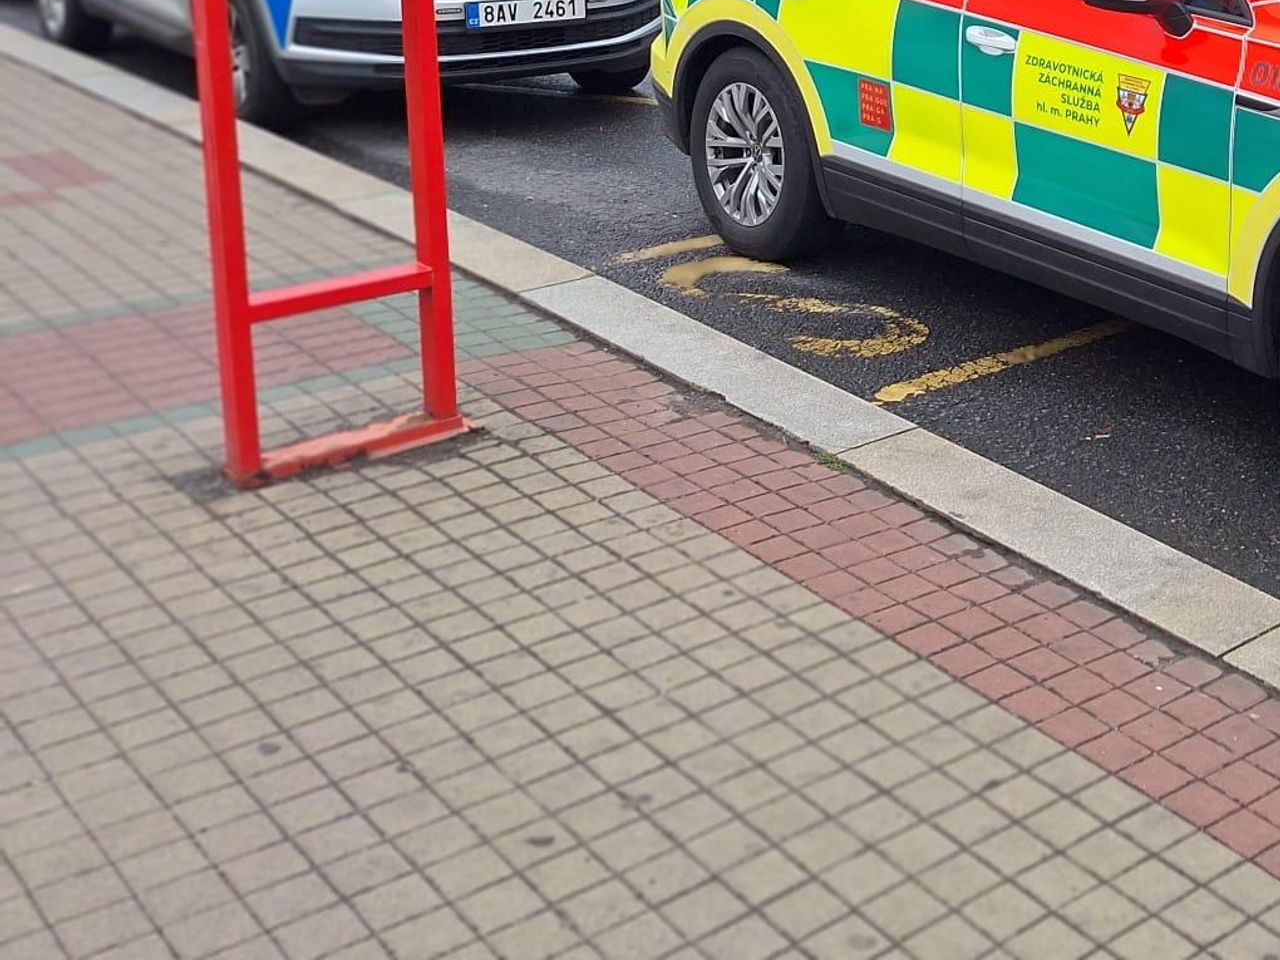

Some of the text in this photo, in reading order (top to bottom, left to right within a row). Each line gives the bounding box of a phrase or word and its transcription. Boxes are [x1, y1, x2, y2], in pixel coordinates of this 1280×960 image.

[484, 0, 576, 23] 8AV 2461
[1025, 54, 1104, 83] ZDRAVOTNICKÁ
[1038, 72, 1102, 98] ZÁCHRANNÁ
[1036, 100, 1100, 127] hl. m. PRAHY
[1060, 93, 1101, 113] SLUŽBA
